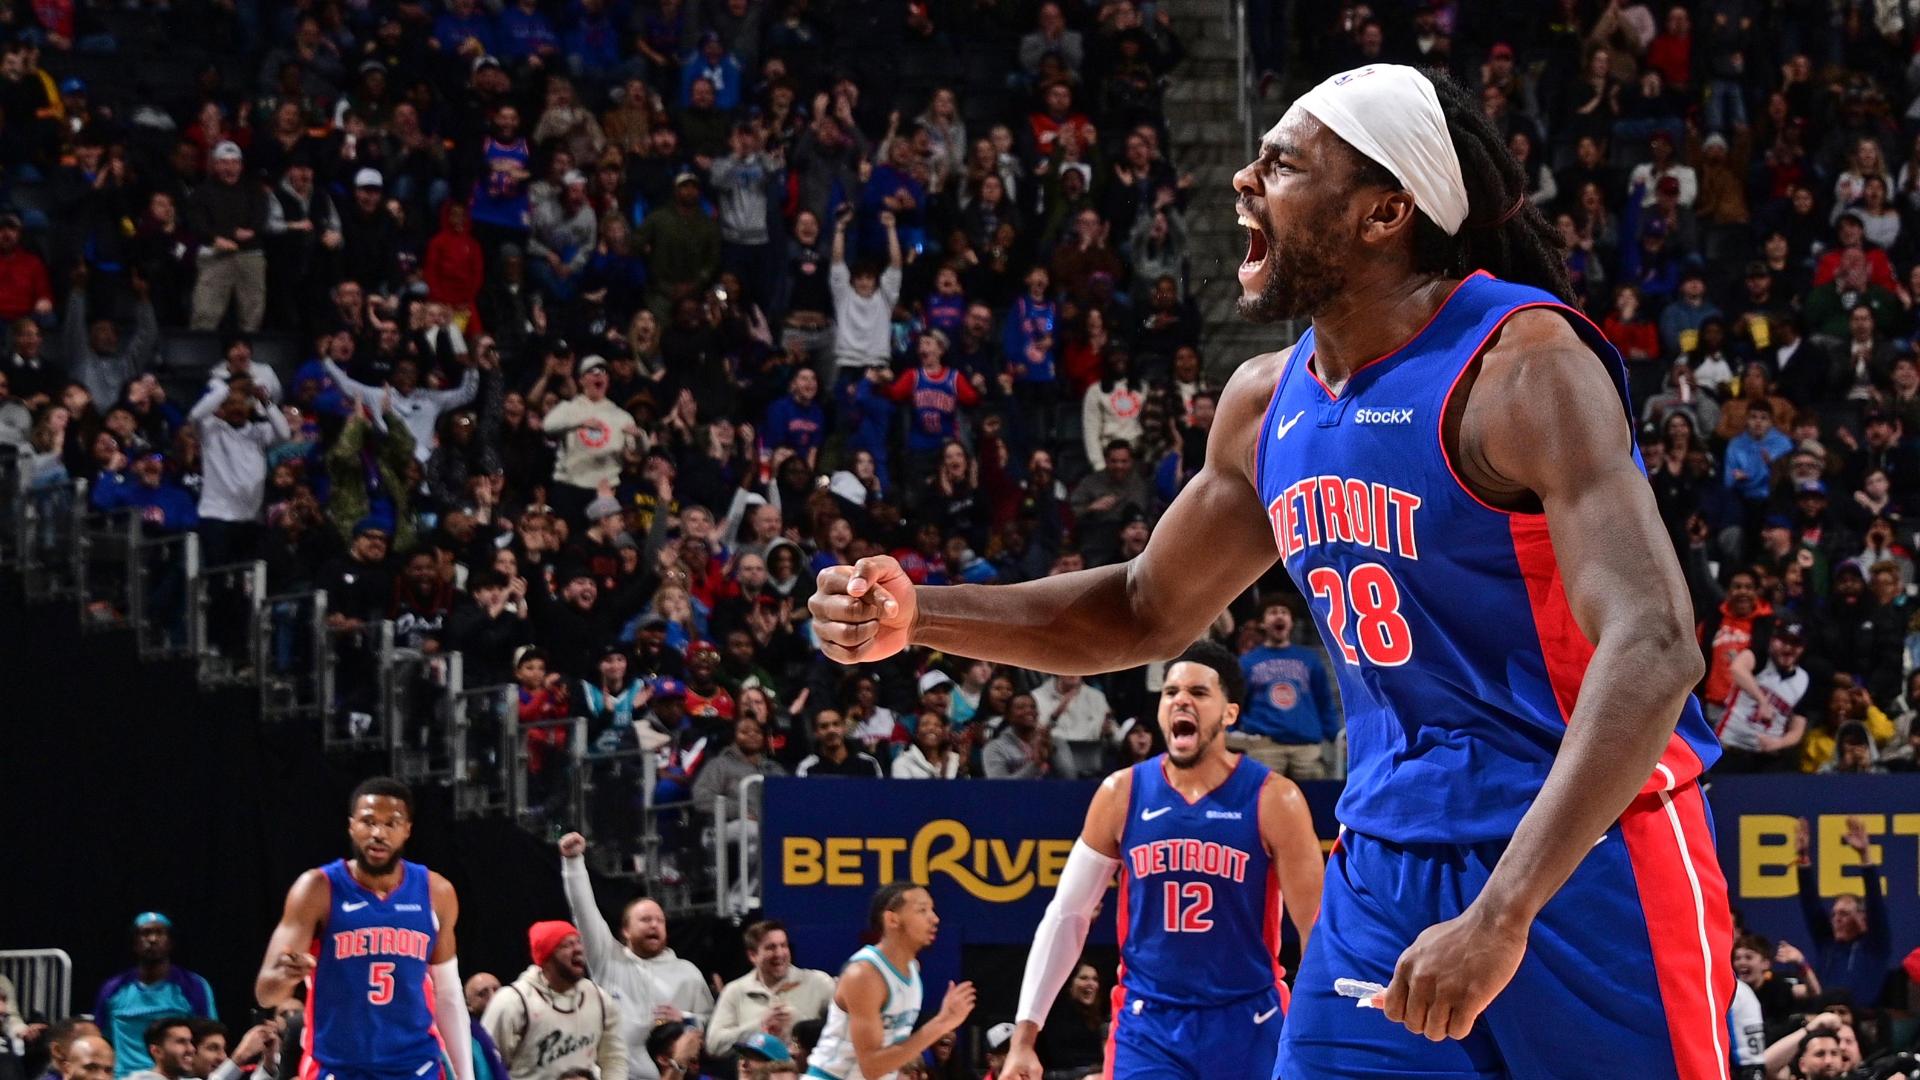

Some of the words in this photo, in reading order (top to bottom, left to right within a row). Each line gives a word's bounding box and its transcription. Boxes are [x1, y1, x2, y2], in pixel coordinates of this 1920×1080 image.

[1355, 409, 1414, 424] StockX
[1268, 475, 1422, 568] DETROIT
[1308, 562, 1413, 667] 28
[783, 819, 1078, 902] BETRIVE
[1129, 839, 1250, 883] DETROIT
[1164, 881, 1214, 932] 12
[334, 927, 431, 960] DETROIT
[368, 962, 396, 1005] 5
